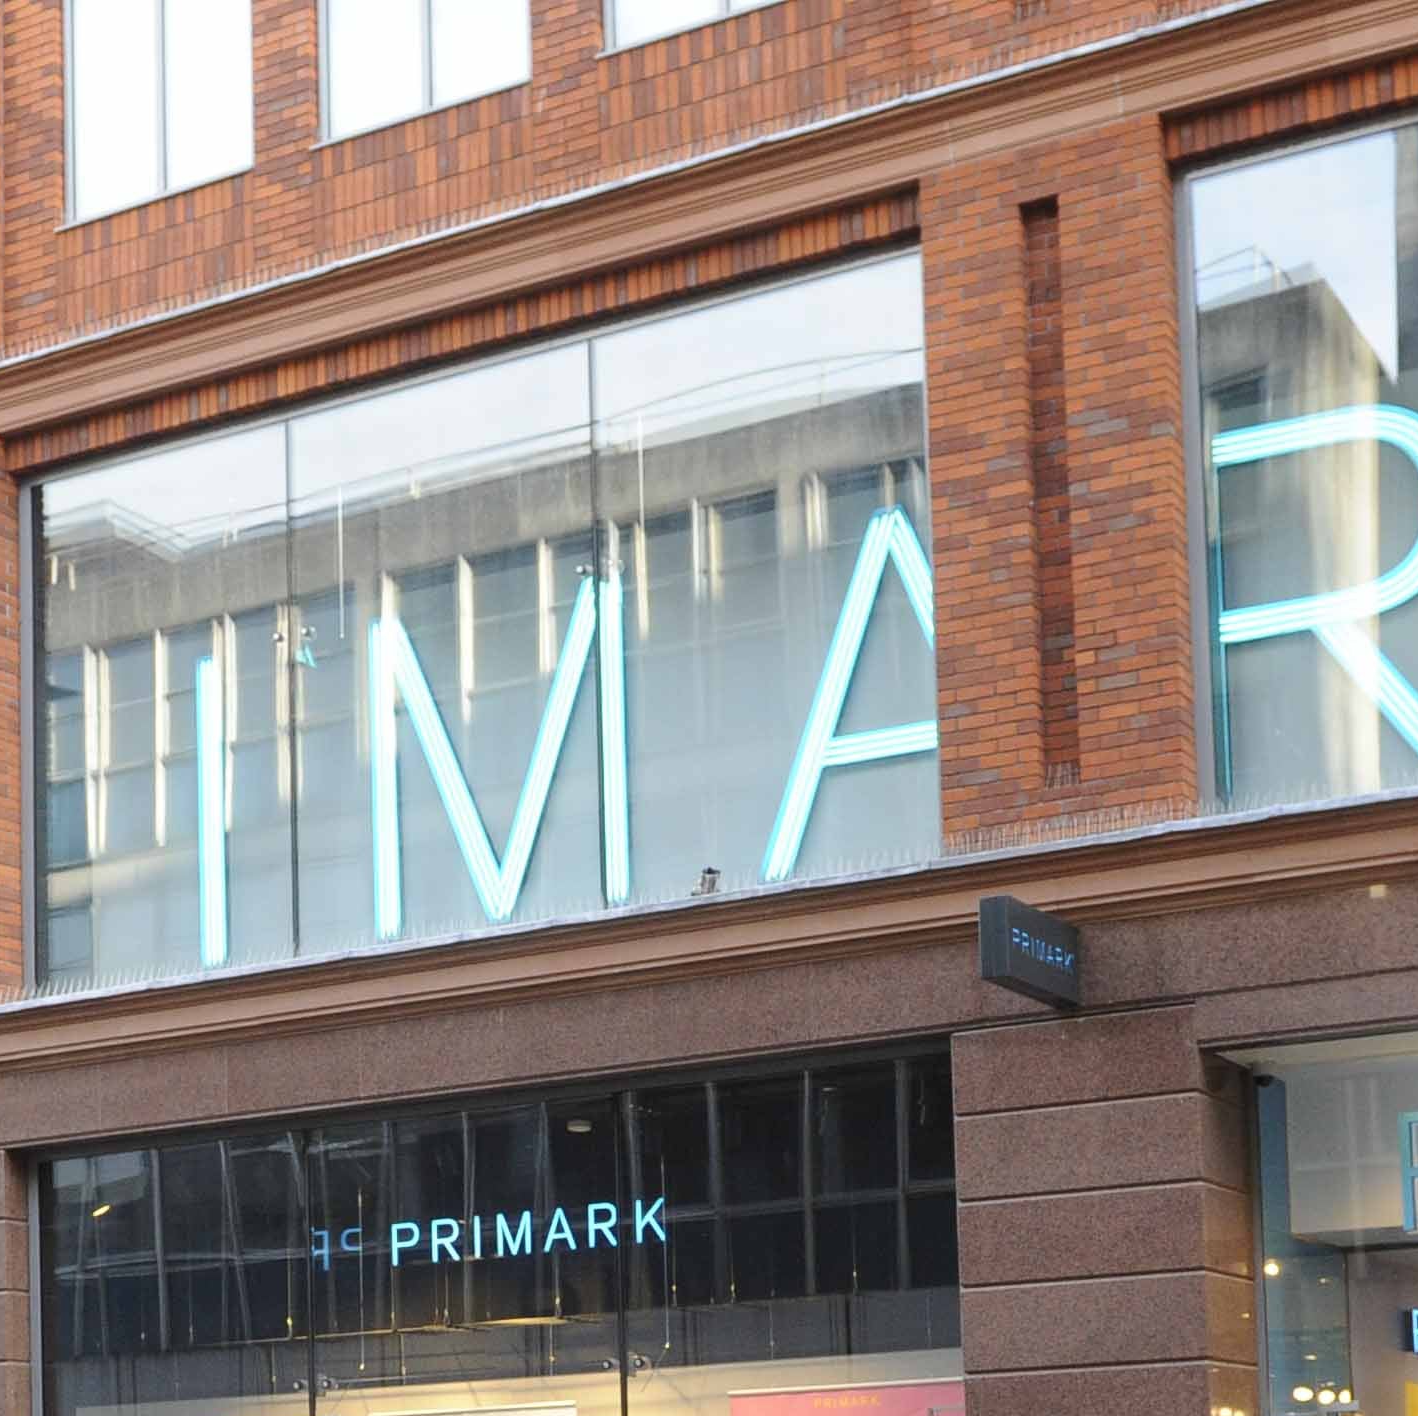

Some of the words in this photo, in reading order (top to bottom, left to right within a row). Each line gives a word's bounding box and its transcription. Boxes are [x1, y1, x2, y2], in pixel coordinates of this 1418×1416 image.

[1012, 927, 1075, 977] PRIMARK
[390, 1196, 667, 1267] PRIMARK
[813, 1393, 881, 1409] PRIMARK
